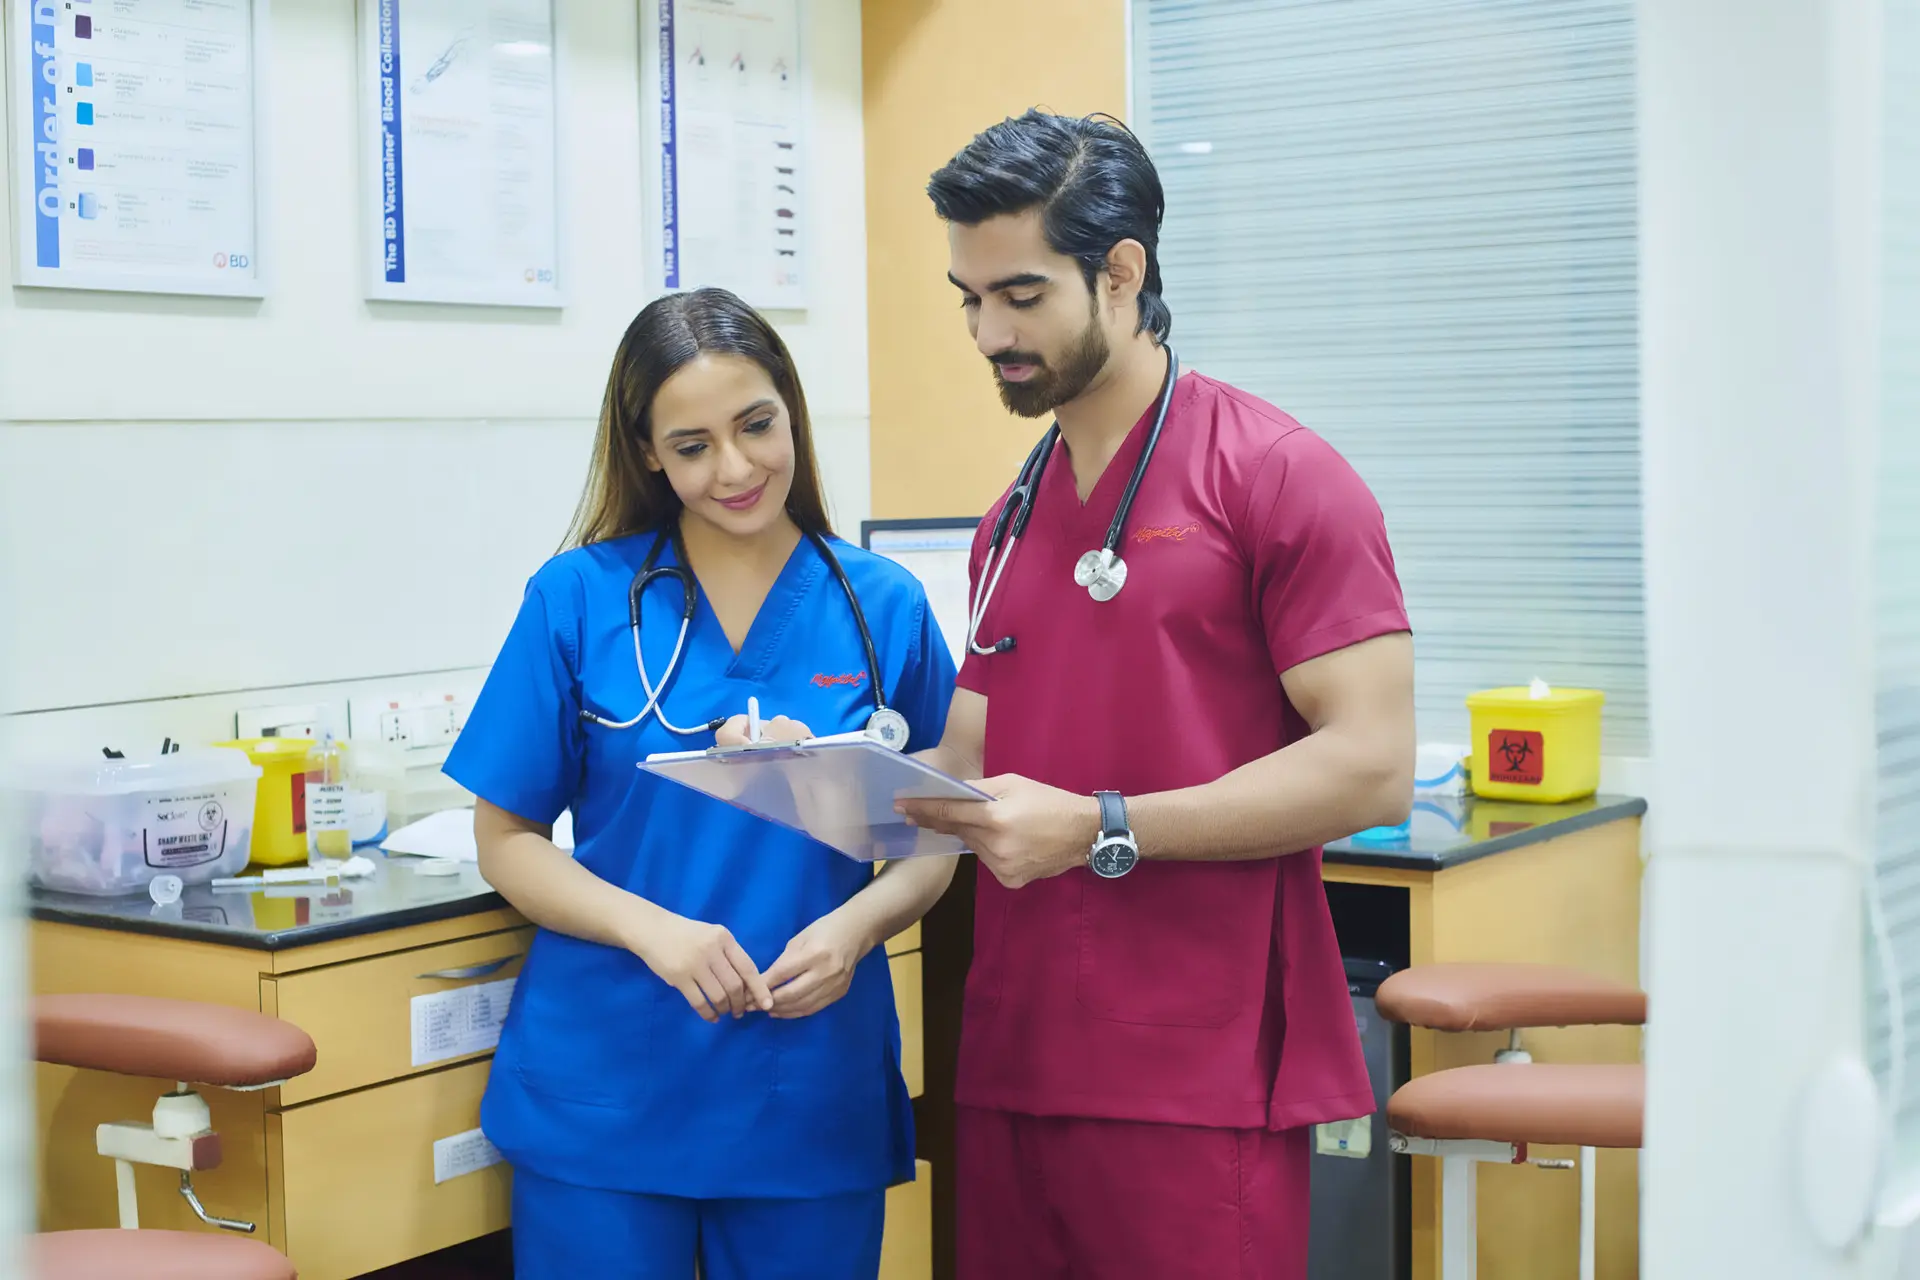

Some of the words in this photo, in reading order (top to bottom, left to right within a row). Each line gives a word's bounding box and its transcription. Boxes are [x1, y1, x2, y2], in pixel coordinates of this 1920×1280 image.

[35, 40, 63, 85] of
[381, 77, 394, 122] Blood
[37, 97, 65, 218] Order
[384, 217, 397, 239] BD
[229, 255, 249, 269] BD
[385, 243, 397, 271] The
[664, 251, 675, 276] The
